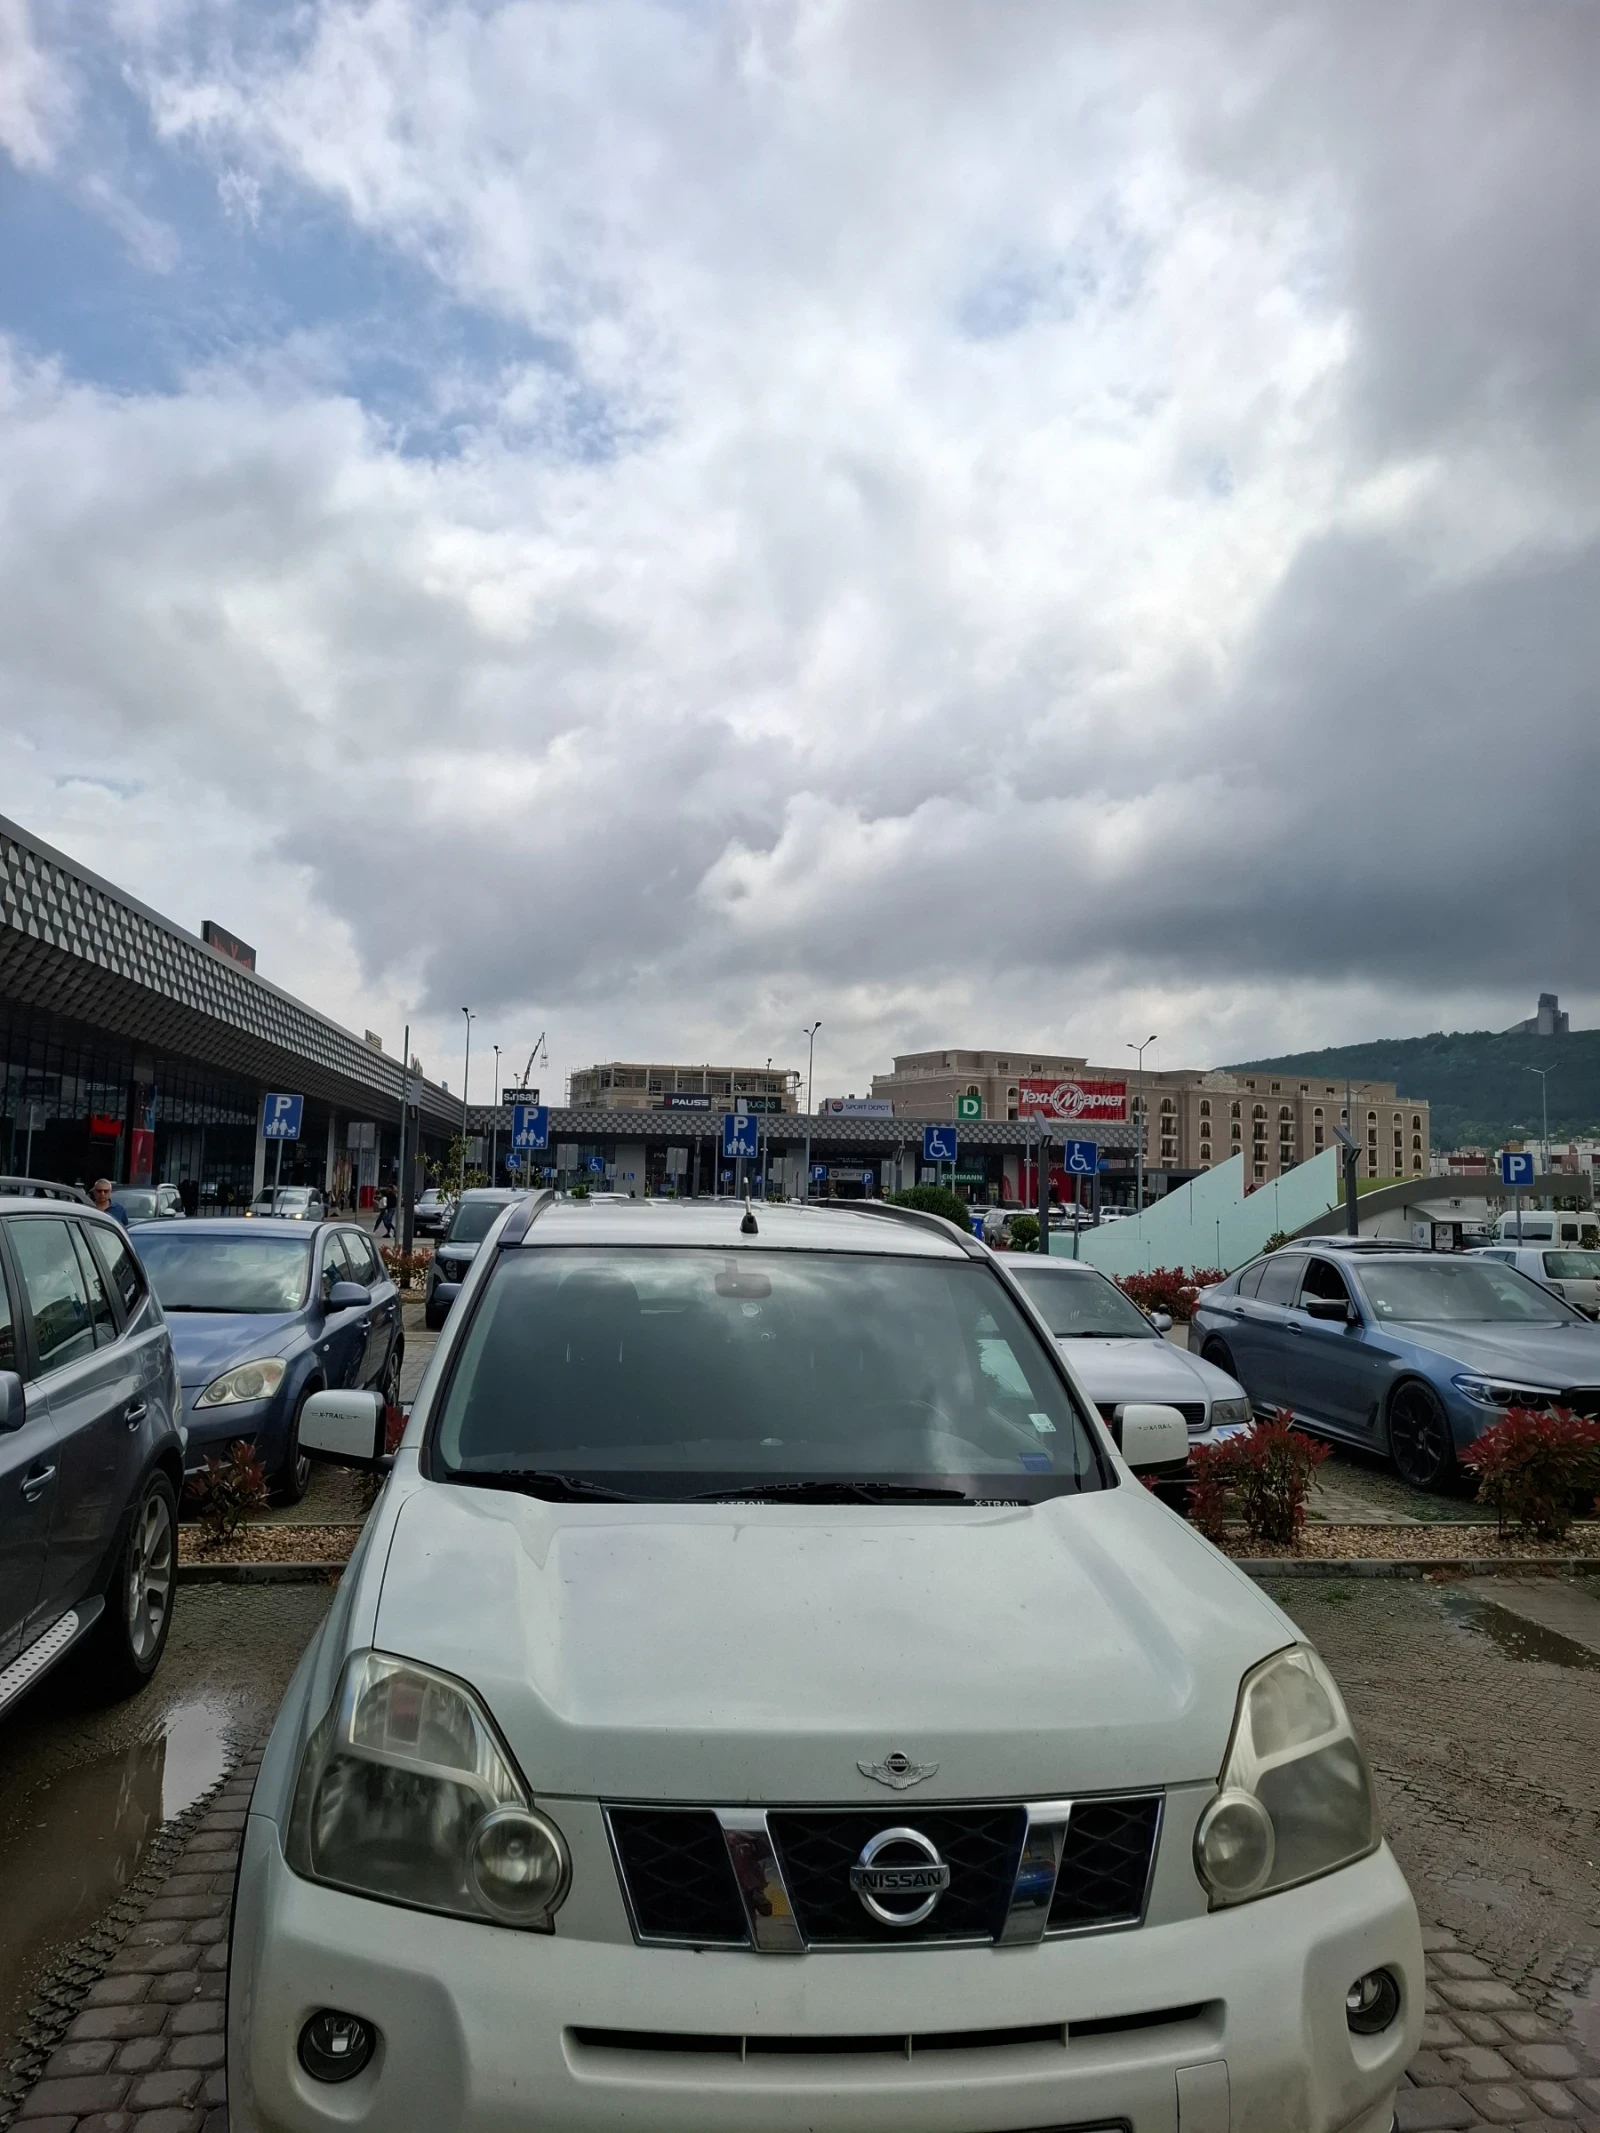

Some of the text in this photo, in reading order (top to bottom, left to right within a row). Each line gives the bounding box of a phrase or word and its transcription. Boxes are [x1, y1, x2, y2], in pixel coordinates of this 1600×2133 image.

[503, 1090, 539, 1104] sinsay
[671, 1098, 710, 1107] PAUSE
[275, 1096, 292, 1117] P
[746, 1100, 776, 1109] OUGLAS
[962, 1099, 979, 1116] D
[523, 1107, 539, 1128] P
[733, 1116, 749, 1137] P
[725, 1171, 731, 1180] P
[814, 1167, 823, 1179] P
[1509, 1156, 1526, 1181] P
[864, 1173, 871, 1183] P
[318, 1412, 345, 1420] X-TRAIL
[862, 1872, 942, 1888] NISSAN
